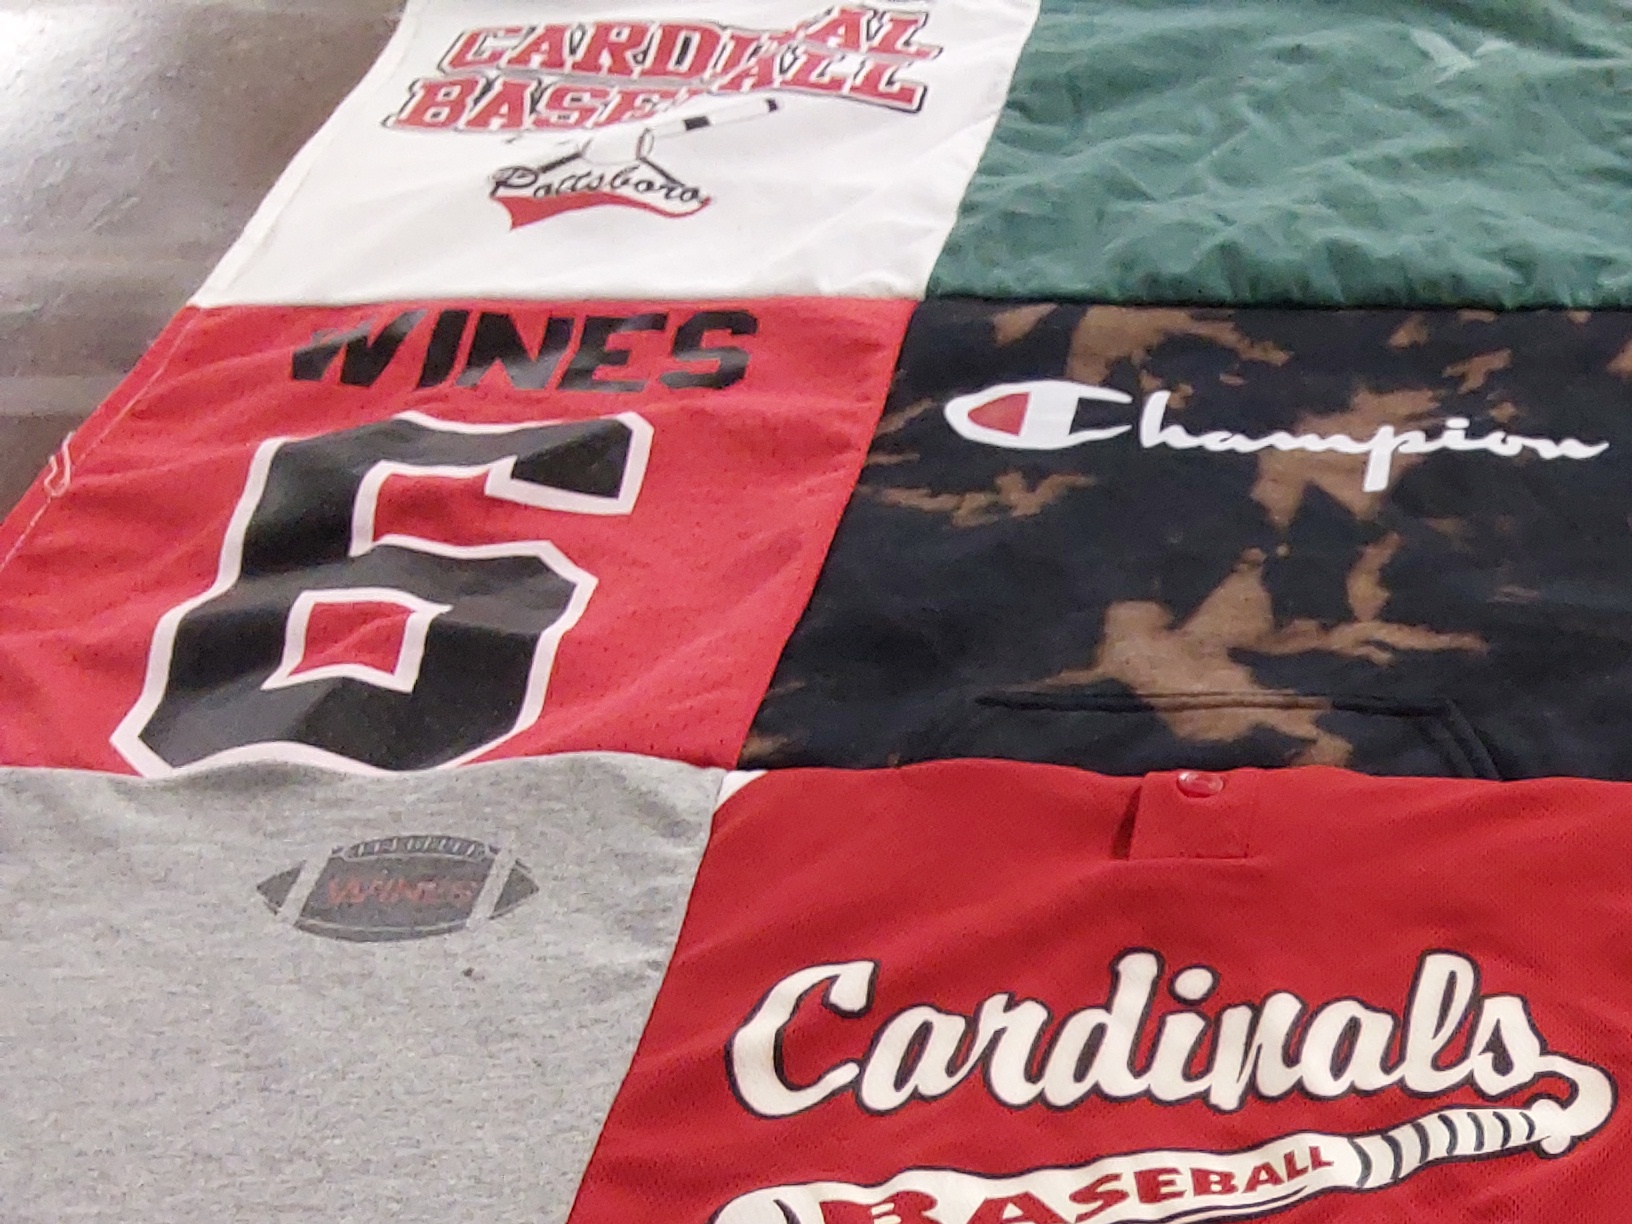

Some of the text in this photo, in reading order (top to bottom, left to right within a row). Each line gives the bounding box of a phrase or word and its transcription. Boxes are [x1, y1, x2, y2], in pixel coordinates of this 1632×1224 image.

[380, 50, 929, 135] BASEALL
[291, 308, 760, 394] WINES
[942, 379, 1611, 493] Champion
[109, 410, 655, 780] 6
[725, 949, 1560, 1118] Cardinals
